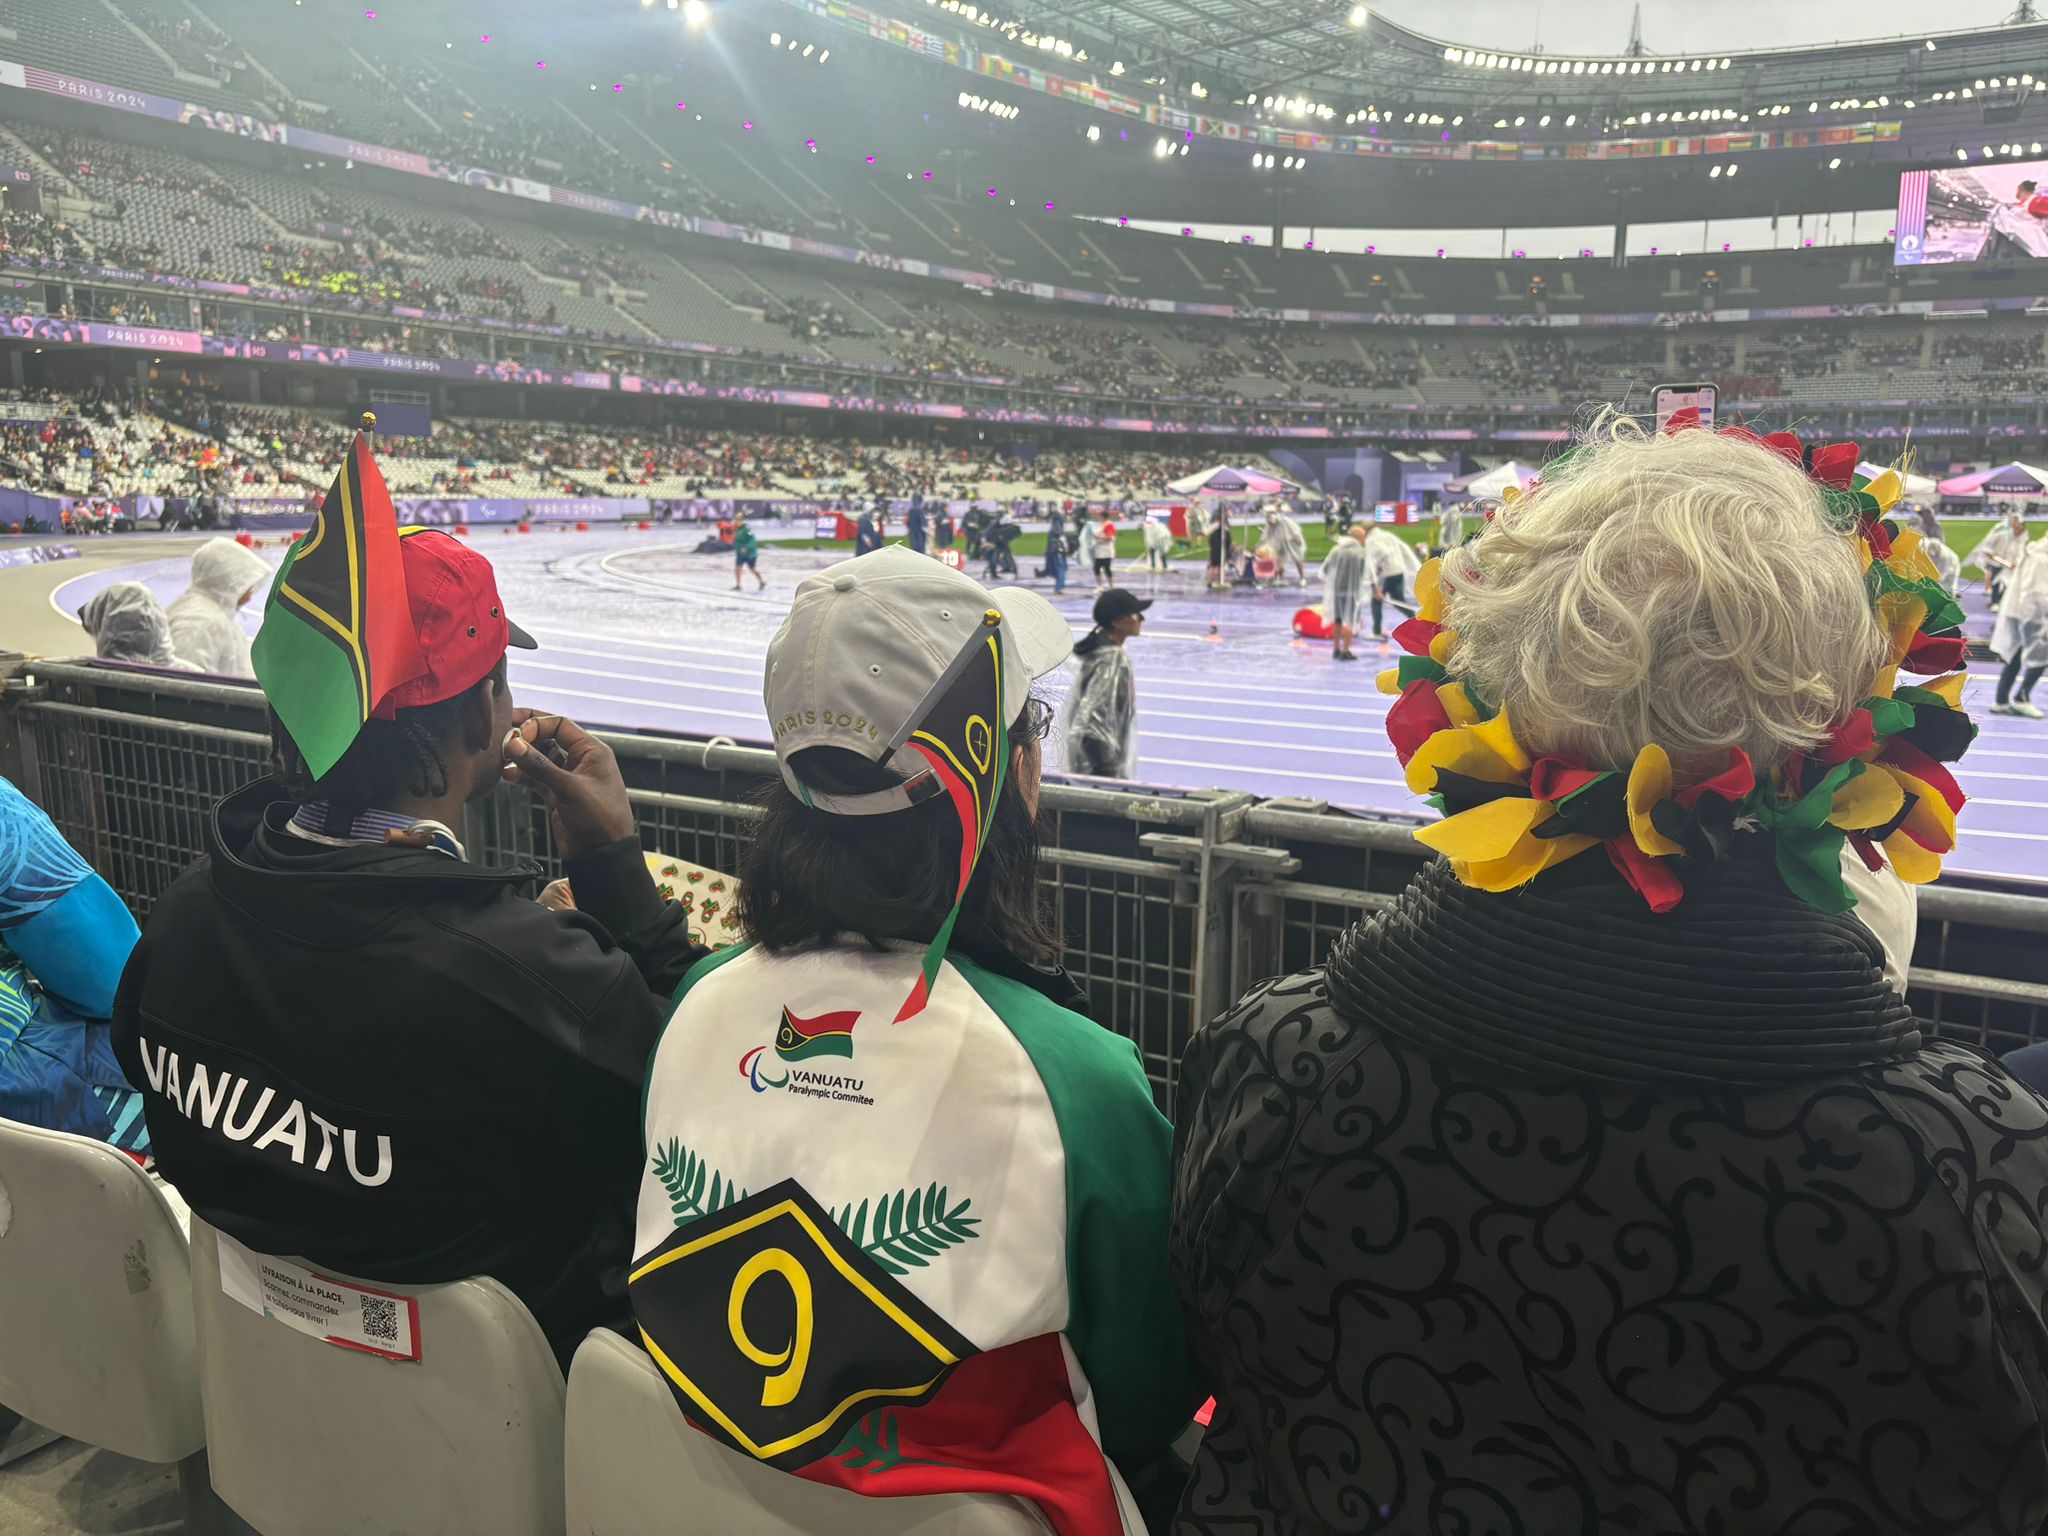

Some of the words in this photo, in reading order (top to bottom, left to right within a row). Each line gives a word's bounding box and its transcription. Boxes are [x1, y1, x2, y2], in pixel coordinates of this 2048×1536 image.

[57, 80, 103, 99] PARIS
[106, 92, 146, 108] 2024
[106, 330, 146, 344] PARIS
[150, 334, 184, 347] 2024
[822, 710, 879, 741] 2024
[792, 1070, 864, 1091] VANUATU
[788, 1083, 831, 1099] Paralympic
[831, 1090, 874, 1106] Commitee
[139, 1035, 393, 1187] VANUATU
[261, 1264, 297, 1288] LIVRAISON
[297, 1279, 304, 1291] À
[305, 1283, 315, 1295] LA
[316, 1288, 345, 1305] PLACE,
[291, 1294, 340, 1316] commandez
